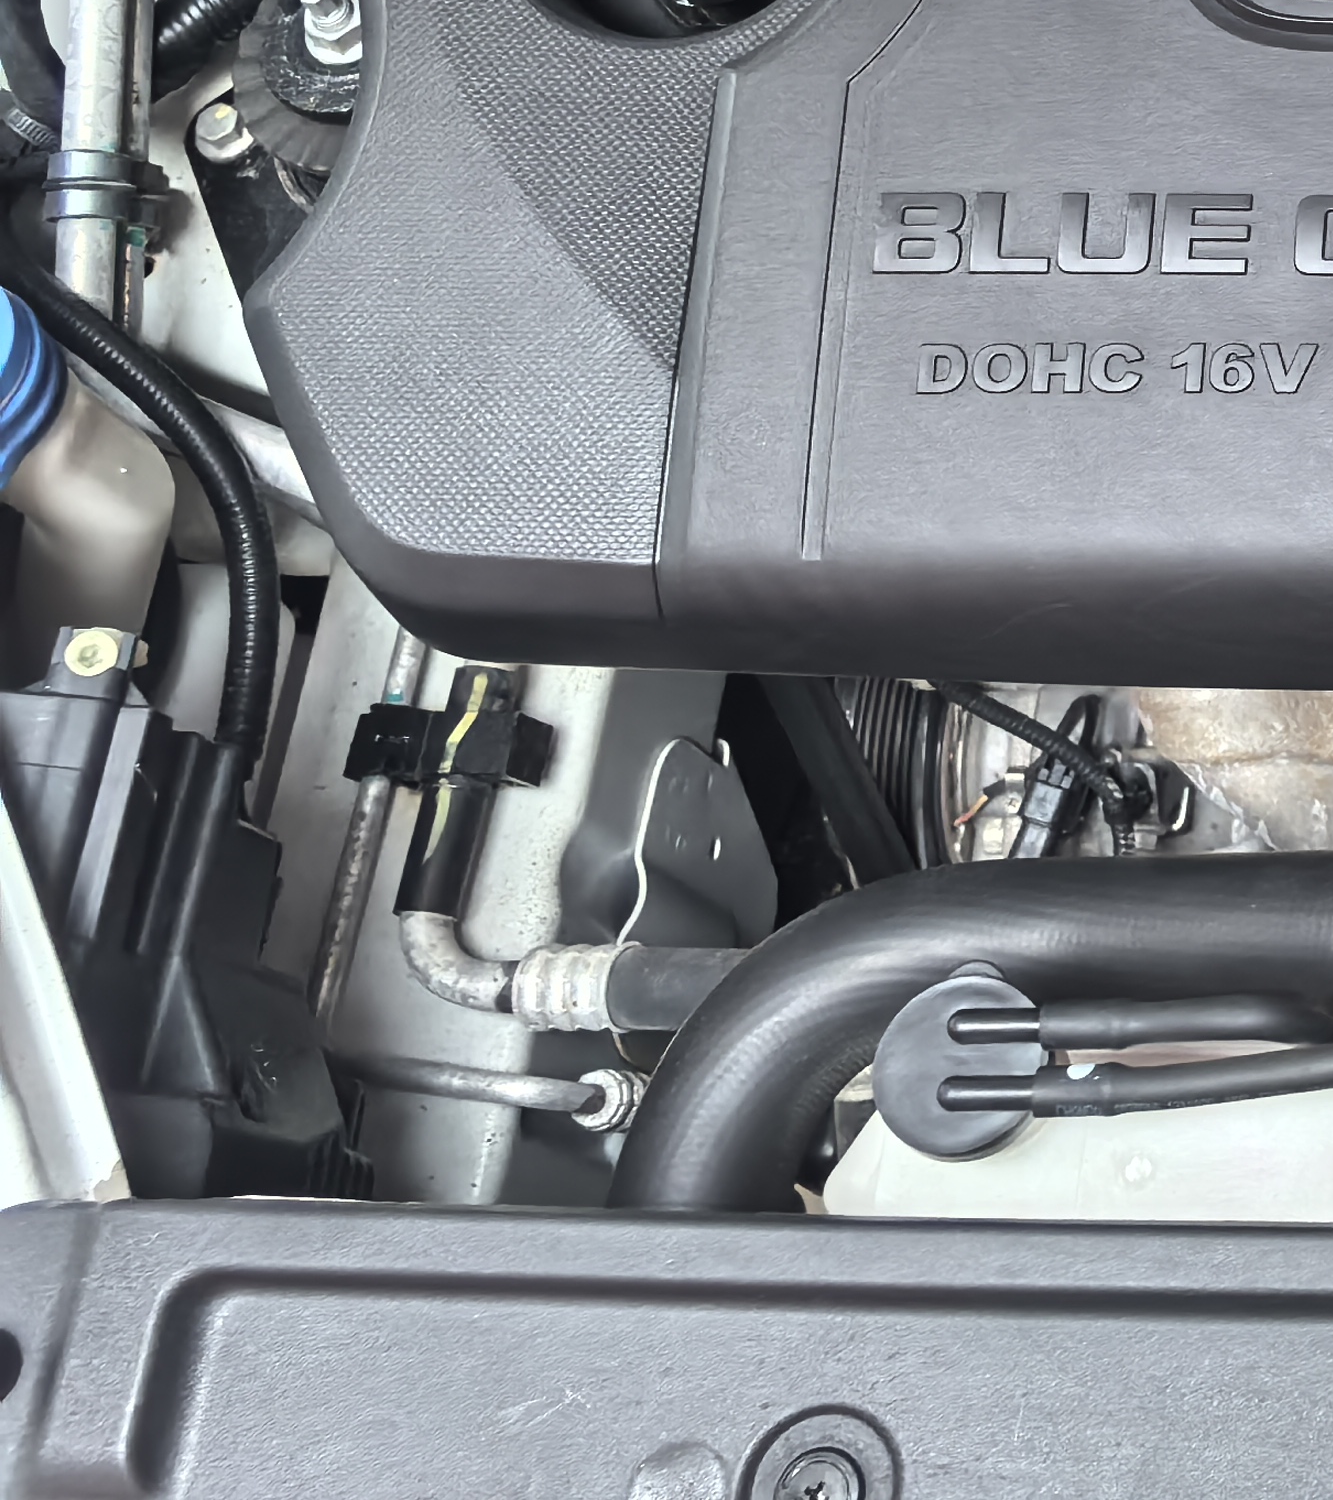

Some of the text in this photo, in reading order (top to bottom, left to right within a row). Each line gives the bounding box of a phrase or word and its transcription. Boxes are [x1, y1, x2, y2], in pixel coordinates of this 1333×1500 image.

[872, 192, 1253, 276] BLUE
[915, 343, 1145, 395] DOHC
[1170, 343, 1320, 395] 16V
